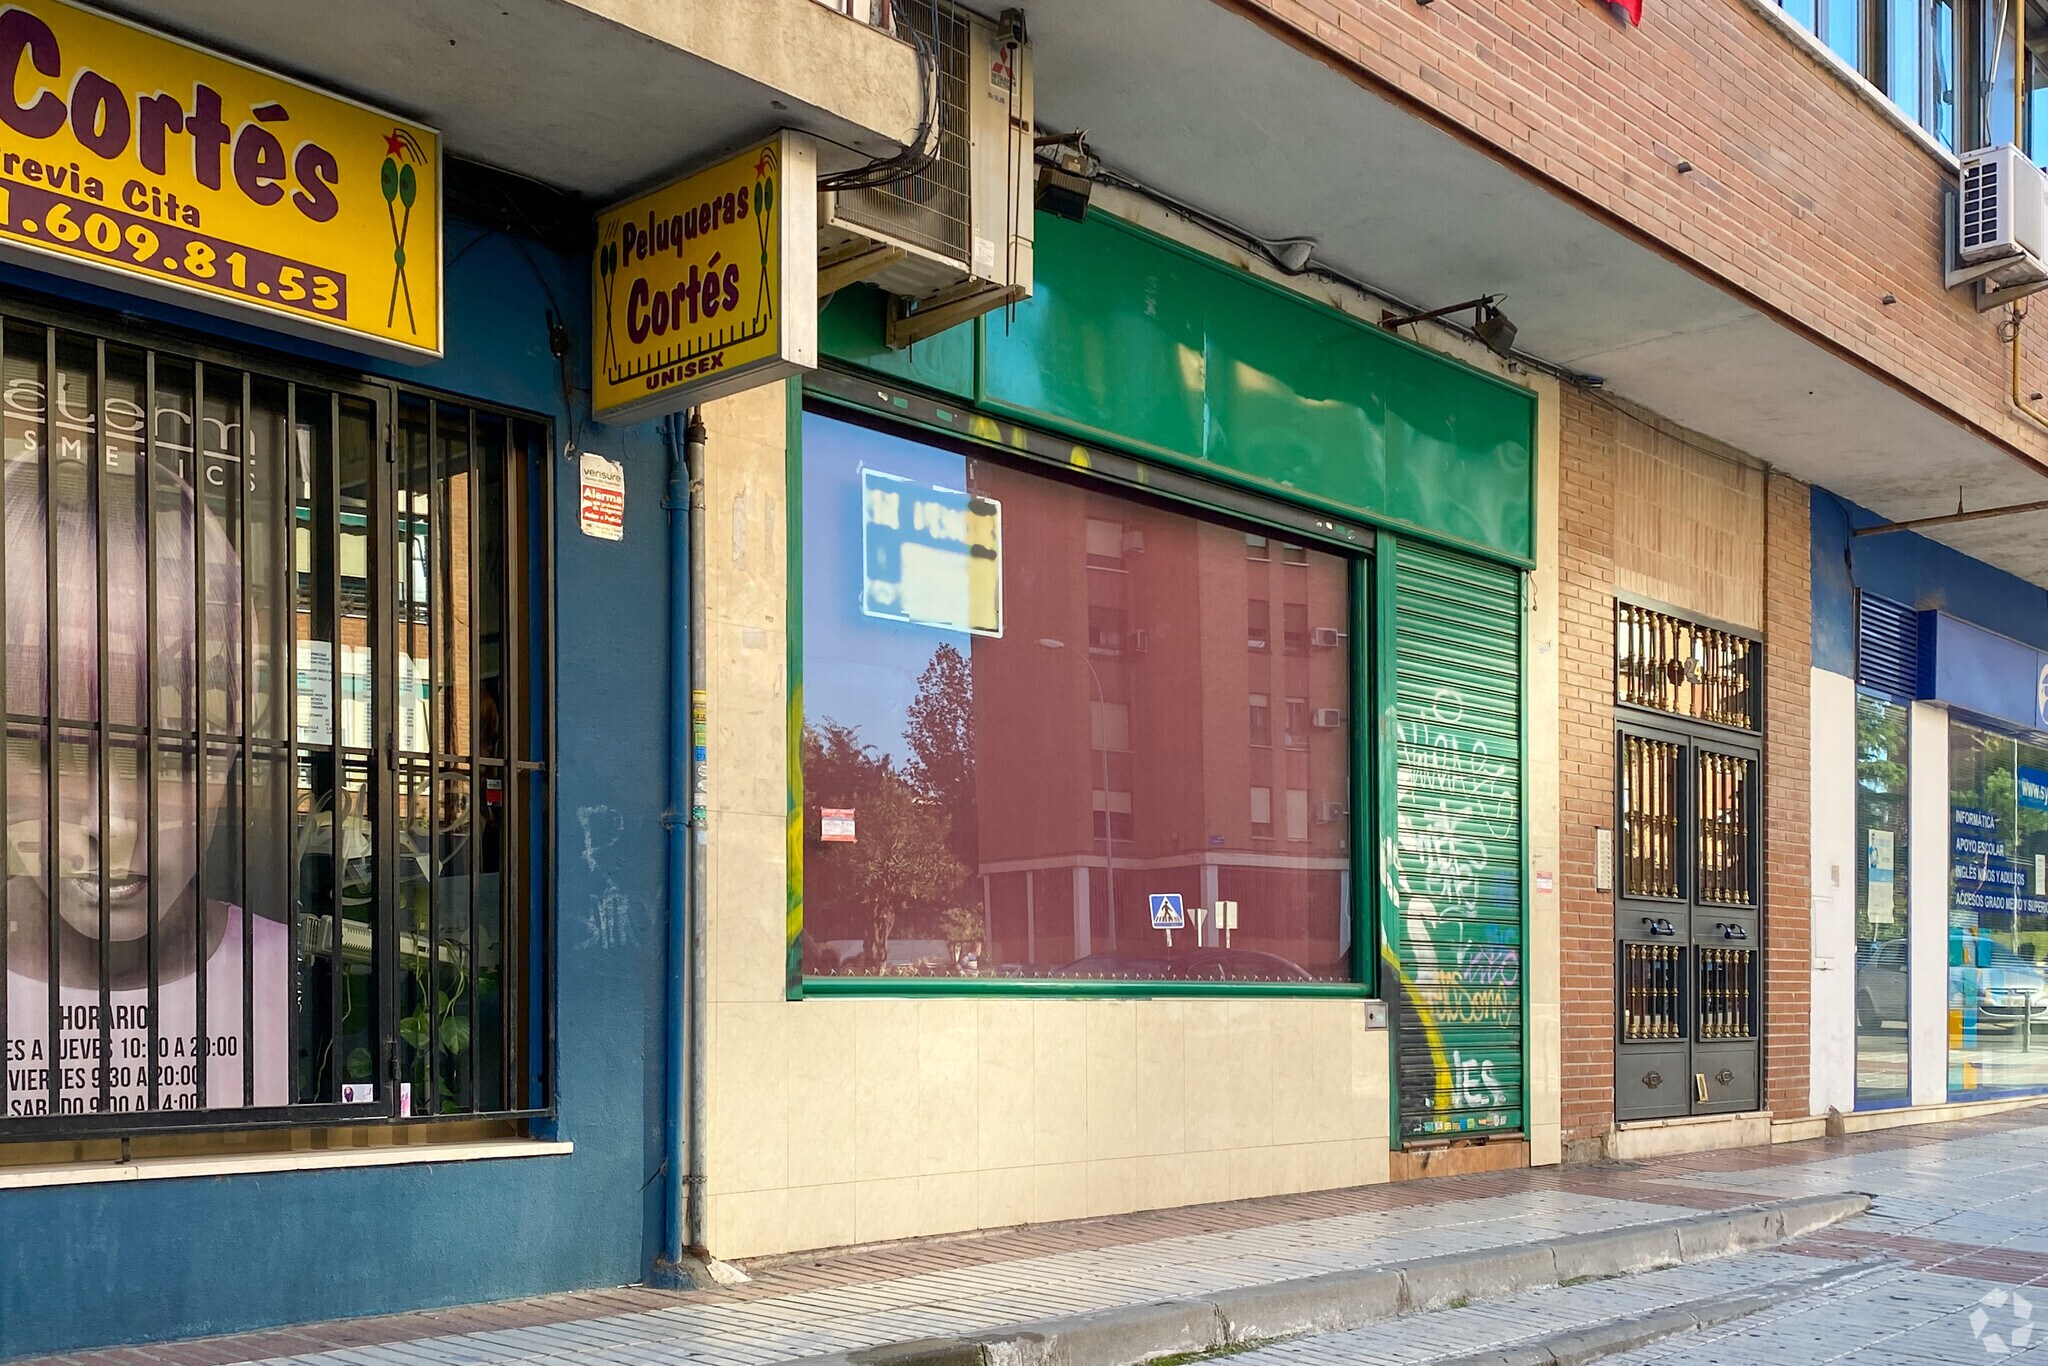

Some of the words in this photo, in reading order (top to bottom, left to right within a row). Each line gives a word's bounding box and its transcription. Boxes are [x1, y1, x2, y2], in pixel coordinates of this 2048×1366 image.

[0, 8, 340, 223] Cortés
[0, 147, 104, 202] revia
[122, 180, 200, 229] Cita
[622, 186, 749, 267] Peluqueras
[626, 251, 740, 344] Cortés
[646, 352, 724, 389] UNISEX
[583, 487, 623, 503] Alarma
[1955, 809, 1995, 829] INFORMÁTICA
[1955, 837, 1977, 853] APOYO
[1977, 840, 2004, 856] ESCOLAR
[1955, 864, 1977, 880] INGLÉS
[1955, 891, 1984, 908] ACCESOS
[1985, 895, 2005, 909] GRADO
[31, 1039, 43, 1060] A
[121, 1037, 169, 1058] 10:0
[174, 1036, 185, 1057] A
[136, 1066, 148, 1087] A
